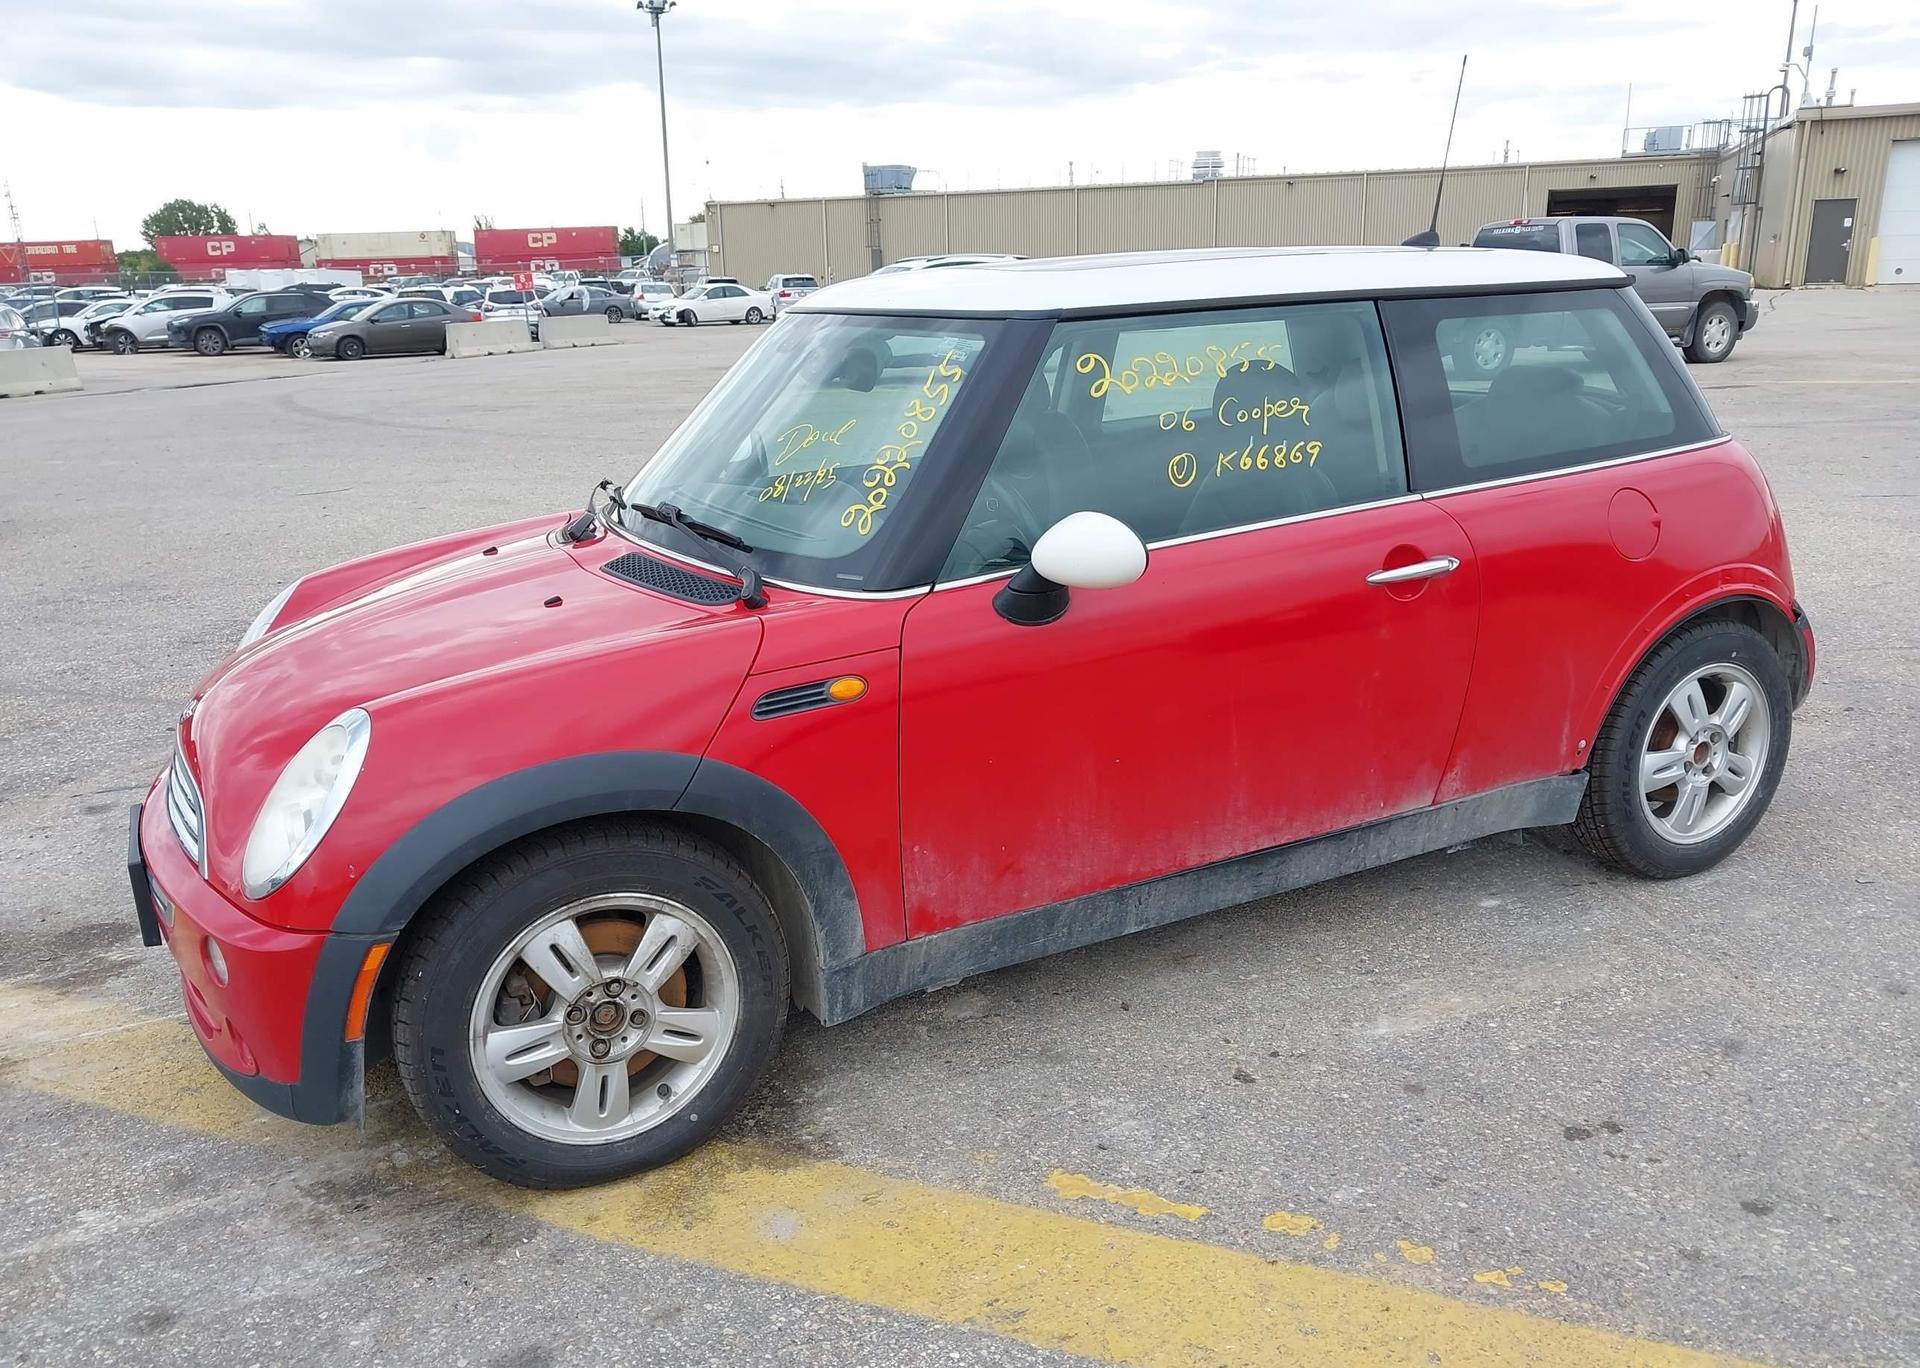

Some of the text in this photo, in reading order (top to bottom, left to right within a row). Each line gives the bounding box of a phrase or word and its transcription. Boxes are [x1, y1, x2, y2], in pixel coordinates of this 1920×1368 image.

[528, 232, 557, 247] CP
[207, 241, 236, 256] CP
[29, 271, 56, 284] CP
[1159, 407, 1196, 431] 06
